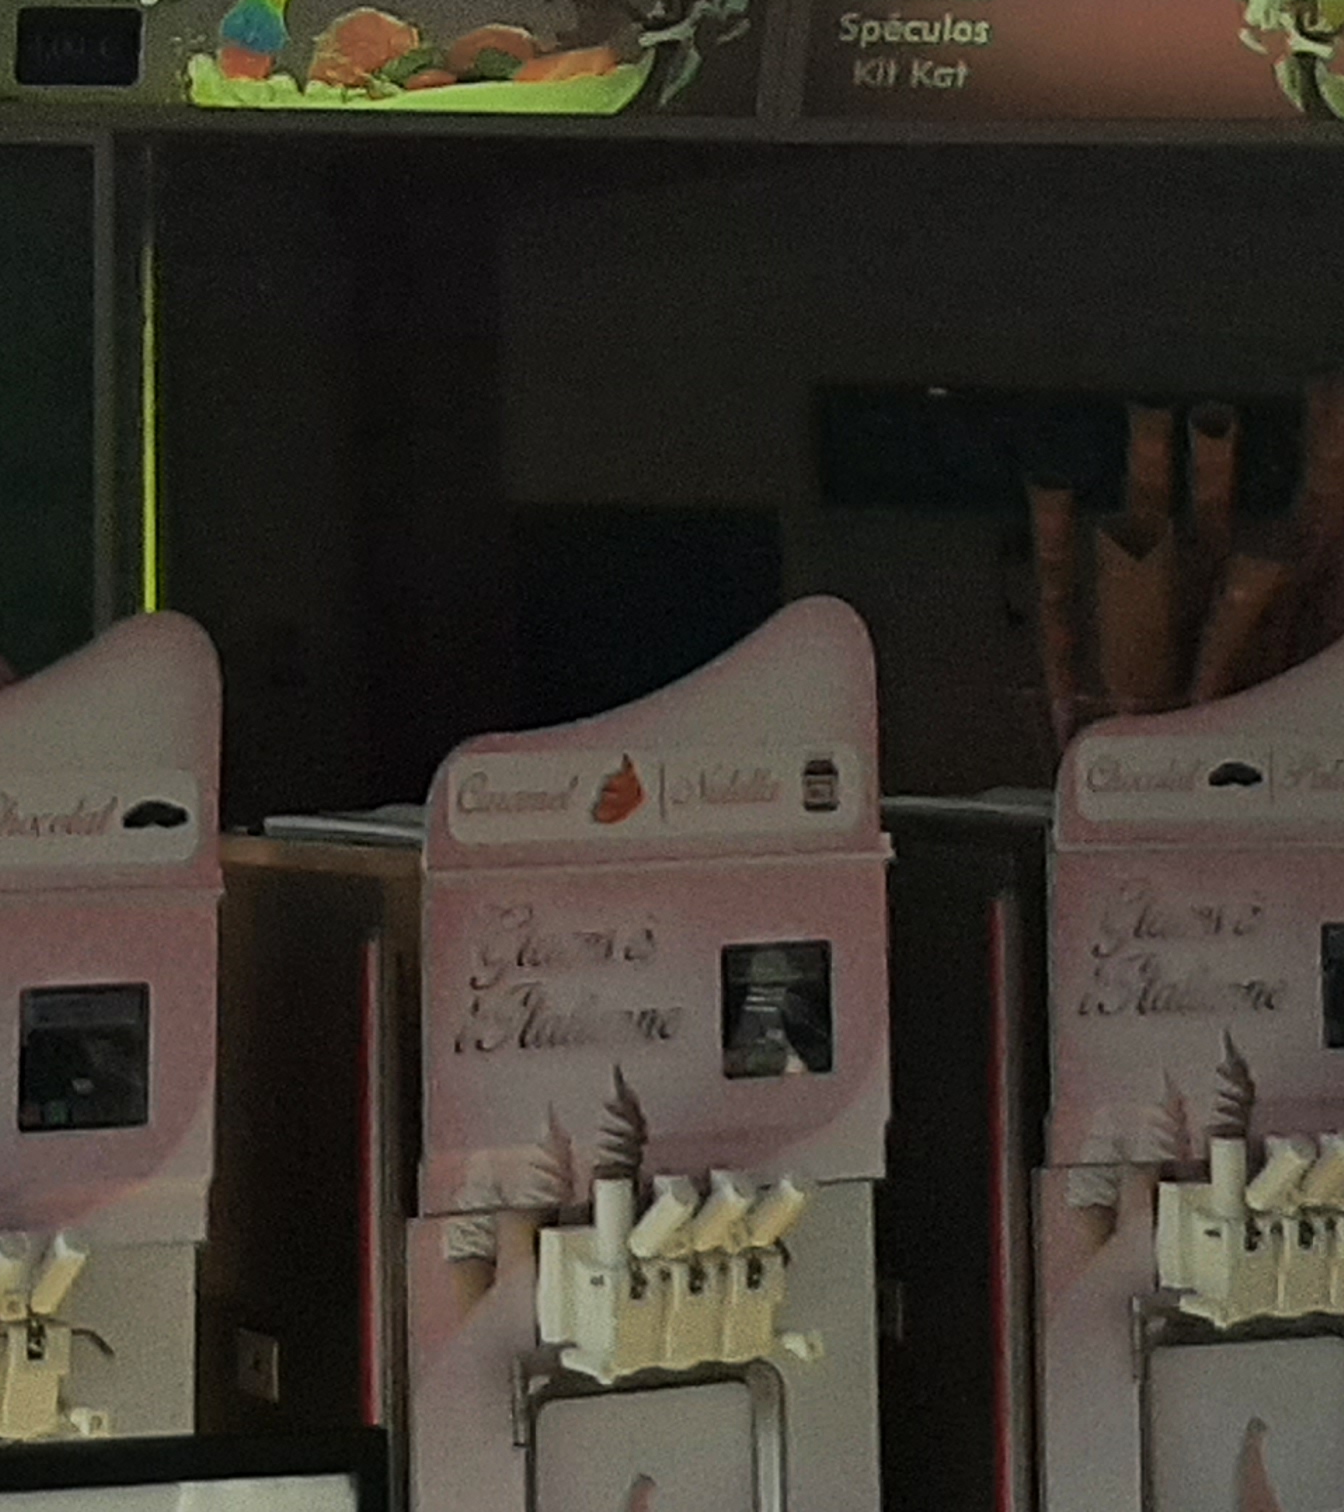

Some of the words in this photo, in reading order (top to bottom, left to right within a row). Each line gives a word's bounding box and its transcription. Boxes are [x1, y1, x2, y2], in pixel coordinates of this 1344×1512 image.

[838, 11, 991, 49] Spéculos
[852, 57, 898, 88] Kit
[910, 58, 971, 90] Kat
